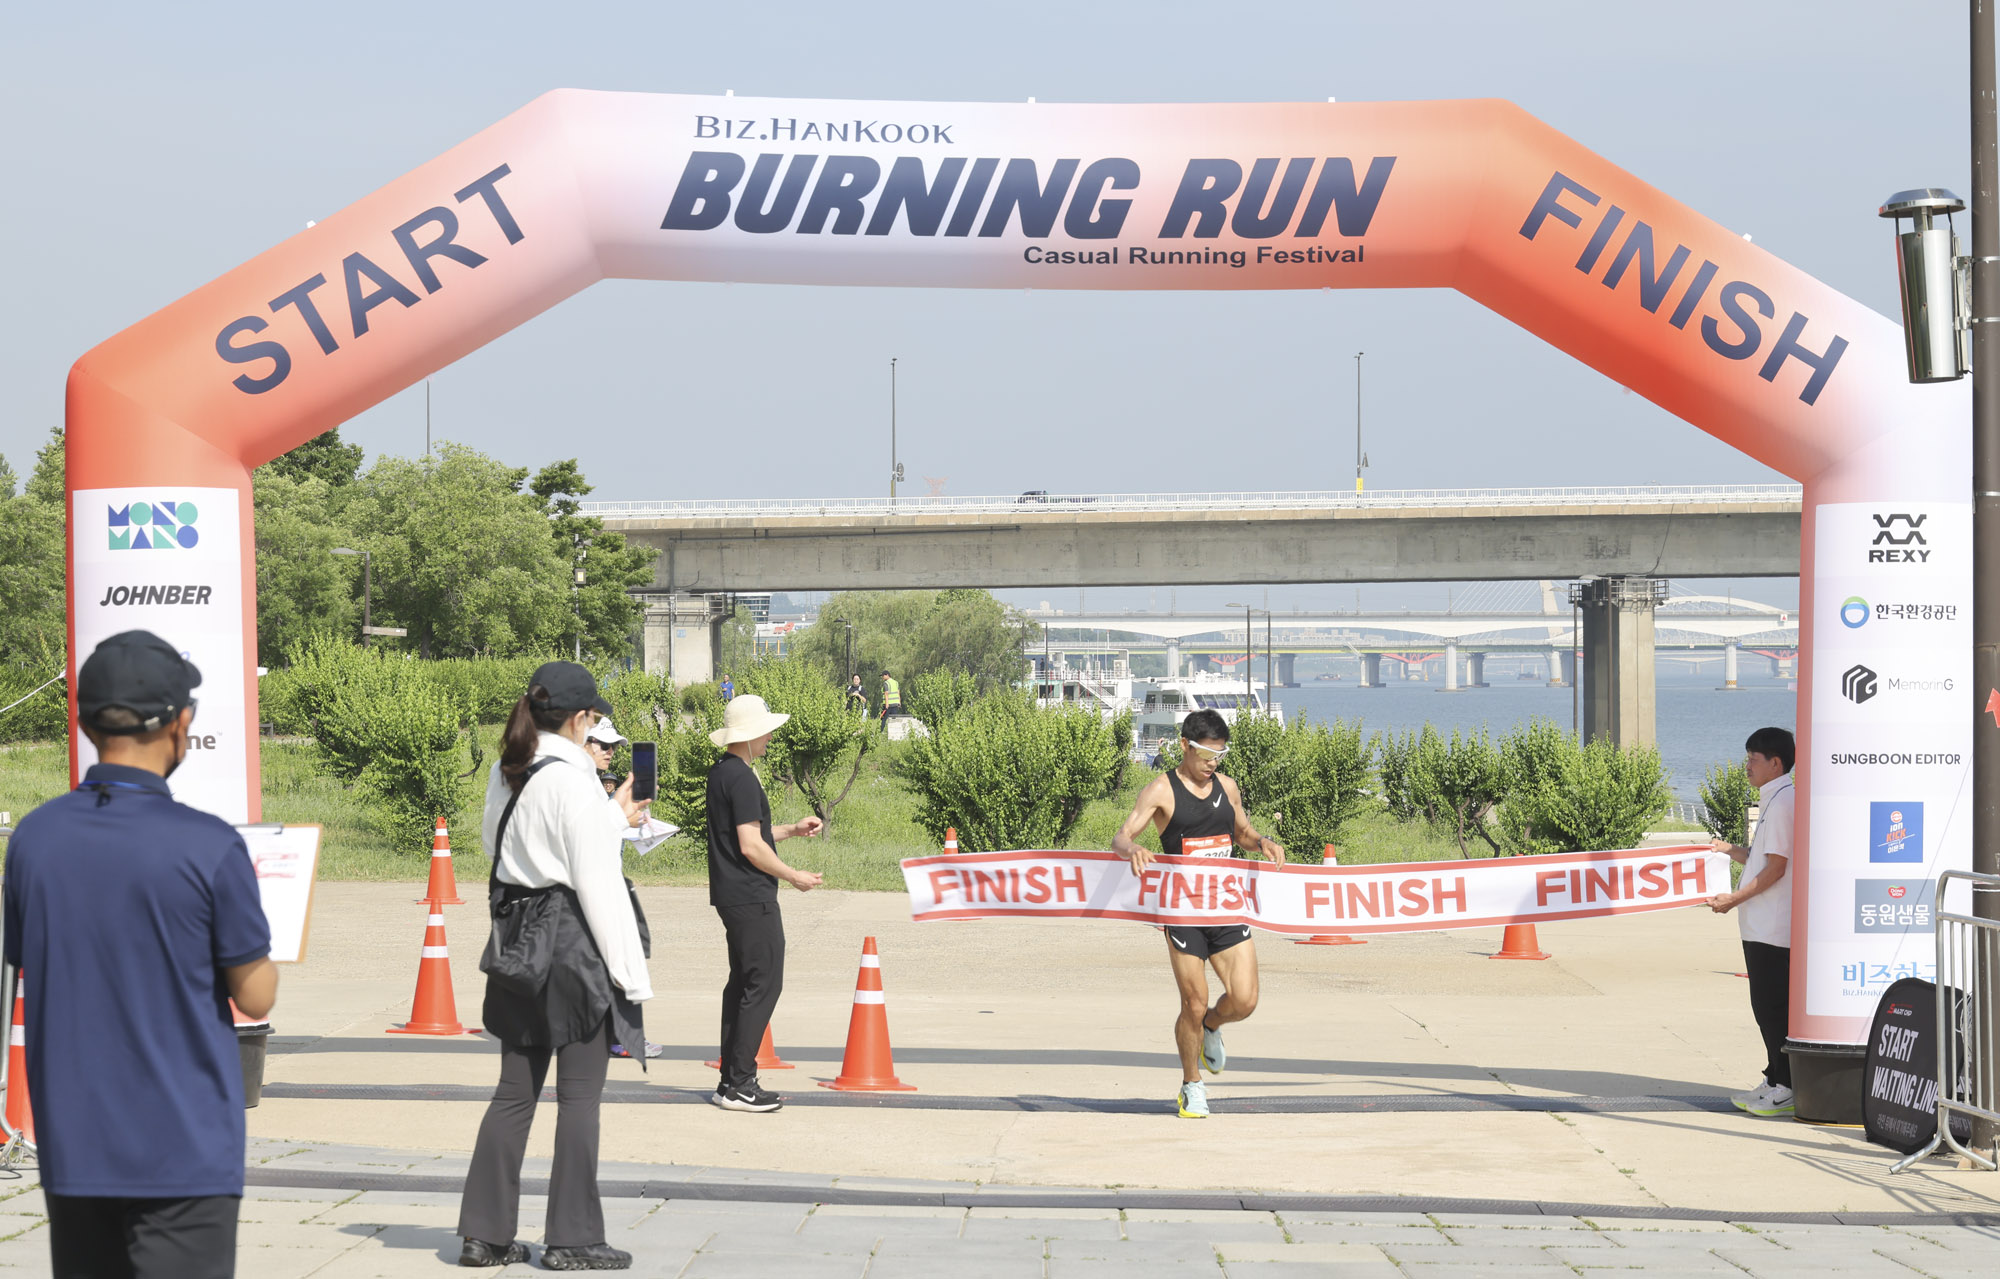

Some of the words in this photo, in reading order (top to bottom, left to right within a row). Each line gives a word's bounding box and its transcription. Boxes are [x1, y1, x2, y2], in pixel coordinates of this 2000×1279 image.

[660, 150, 1142, 240] BURNING
[1157, 155, 1398, 240] RUN
[1023, 246, 1119, 265] Casual
[1128, 246, 1247, 268] Running
[1256, 245, 1365, 265] Festival
[214, 162, 526, 396] START
[1518, 170, 1850, 407] FINISH
[1868, 549, 1931, 563] REXY
[100, 585, 212, 606] JOHNBER
[1875, 603, 1958, 621] 한국환경공단
[1888, 677, 1954, 691] MemorinG
[1831, 753, 1912, 765] SUNGBOON
[1915, 753, 1961, 765] EDITOR
[929, 864, 1087, 906] FINISH
[1138, 869, 1261, 914] FINISH
[1304, 876, 1467, 919] FINISH
[1536, 857, 1707, 907] FINISH
[1860, 903, 1931, 927] 동원샘물
[1878, 1023, 1919, 1063] START
[1871, 1066, 1917, 1108] WAITING
[1912, 1077, 1938, 1115] LINE
